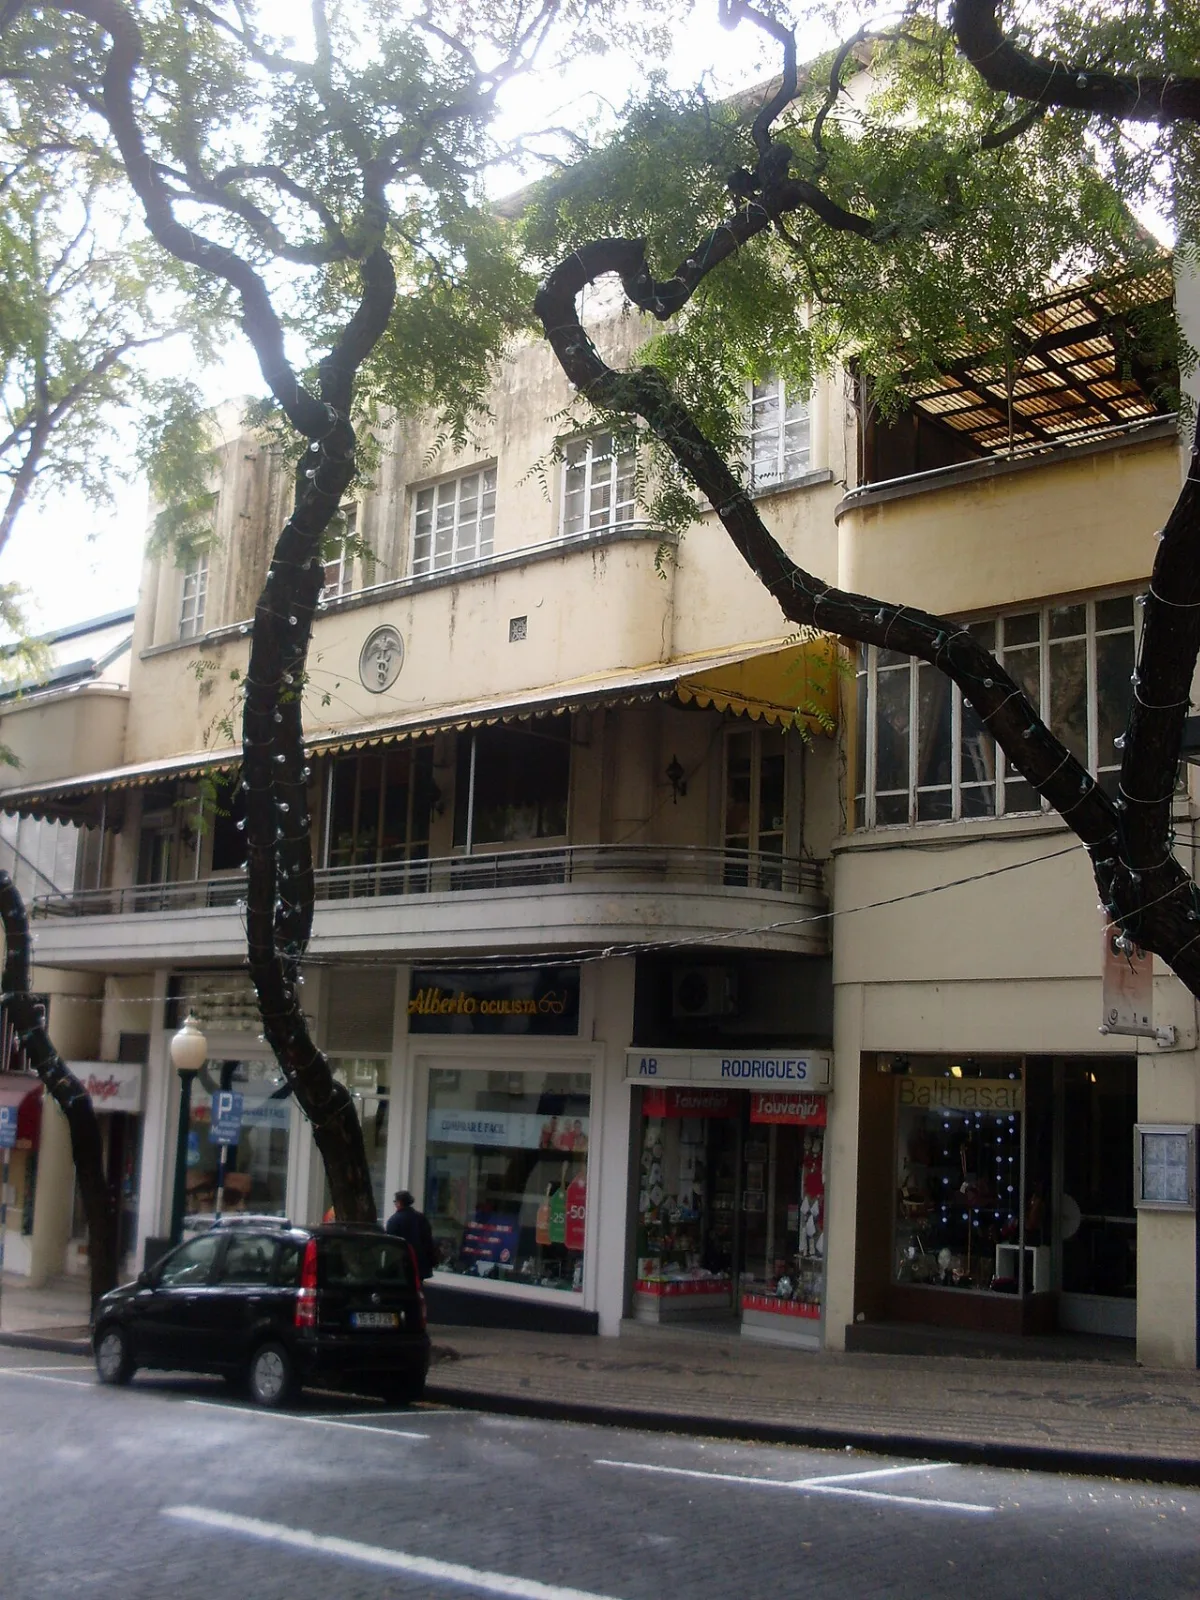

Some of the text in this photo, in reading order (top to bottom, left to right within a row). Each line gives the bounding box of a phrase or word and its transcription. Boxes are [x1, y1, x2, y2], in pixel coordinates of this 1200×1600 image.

[409, 987, 537, 1015] Alberto OCULISTA
[639, 1058, 807, 1079] AB RODRIGUES
[899, 1079, 1021, 1110] Balthasar
[757, 1097, 819, 1119] Souvenirs
